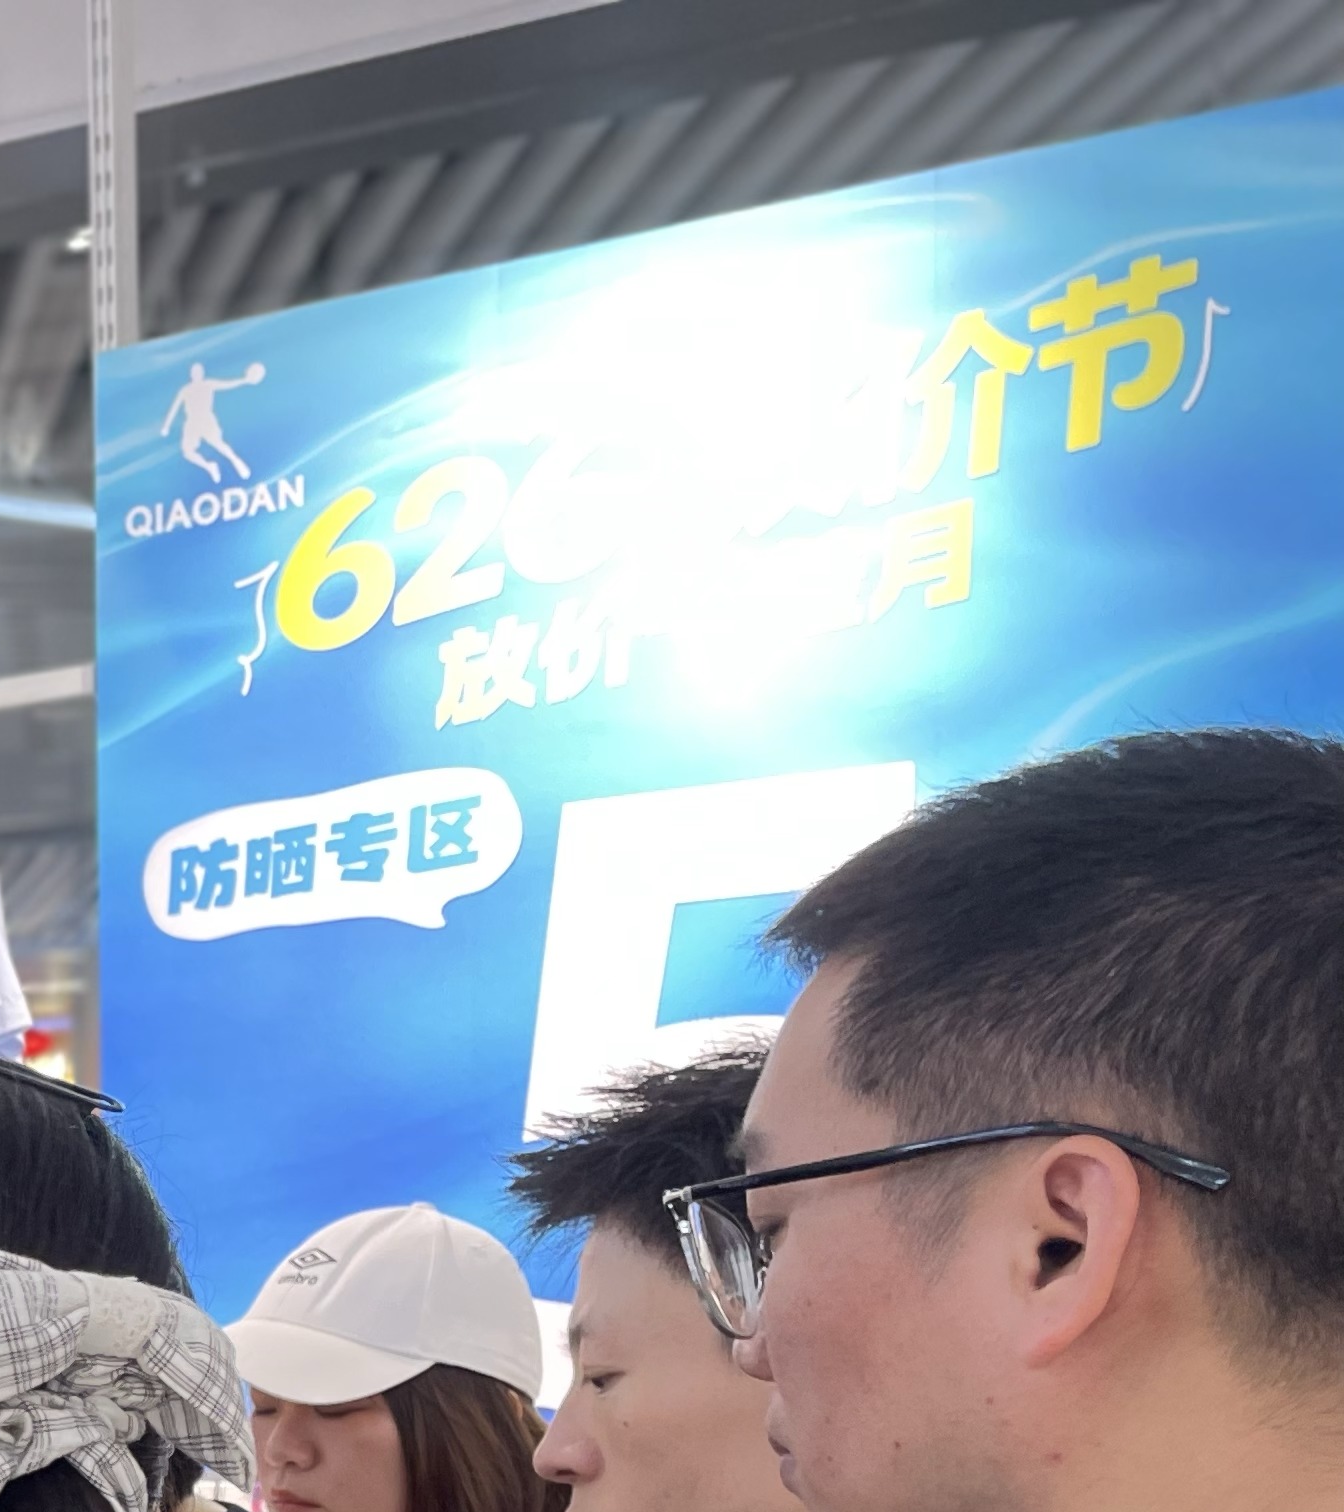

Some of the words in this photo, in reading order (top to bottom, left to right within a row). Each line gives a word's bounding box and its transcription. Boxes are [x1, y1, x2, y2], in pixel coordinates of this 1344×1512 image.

[124, 474, 305, 538] QIAODAN
[167, 795, 482, 917] 防晒专区
